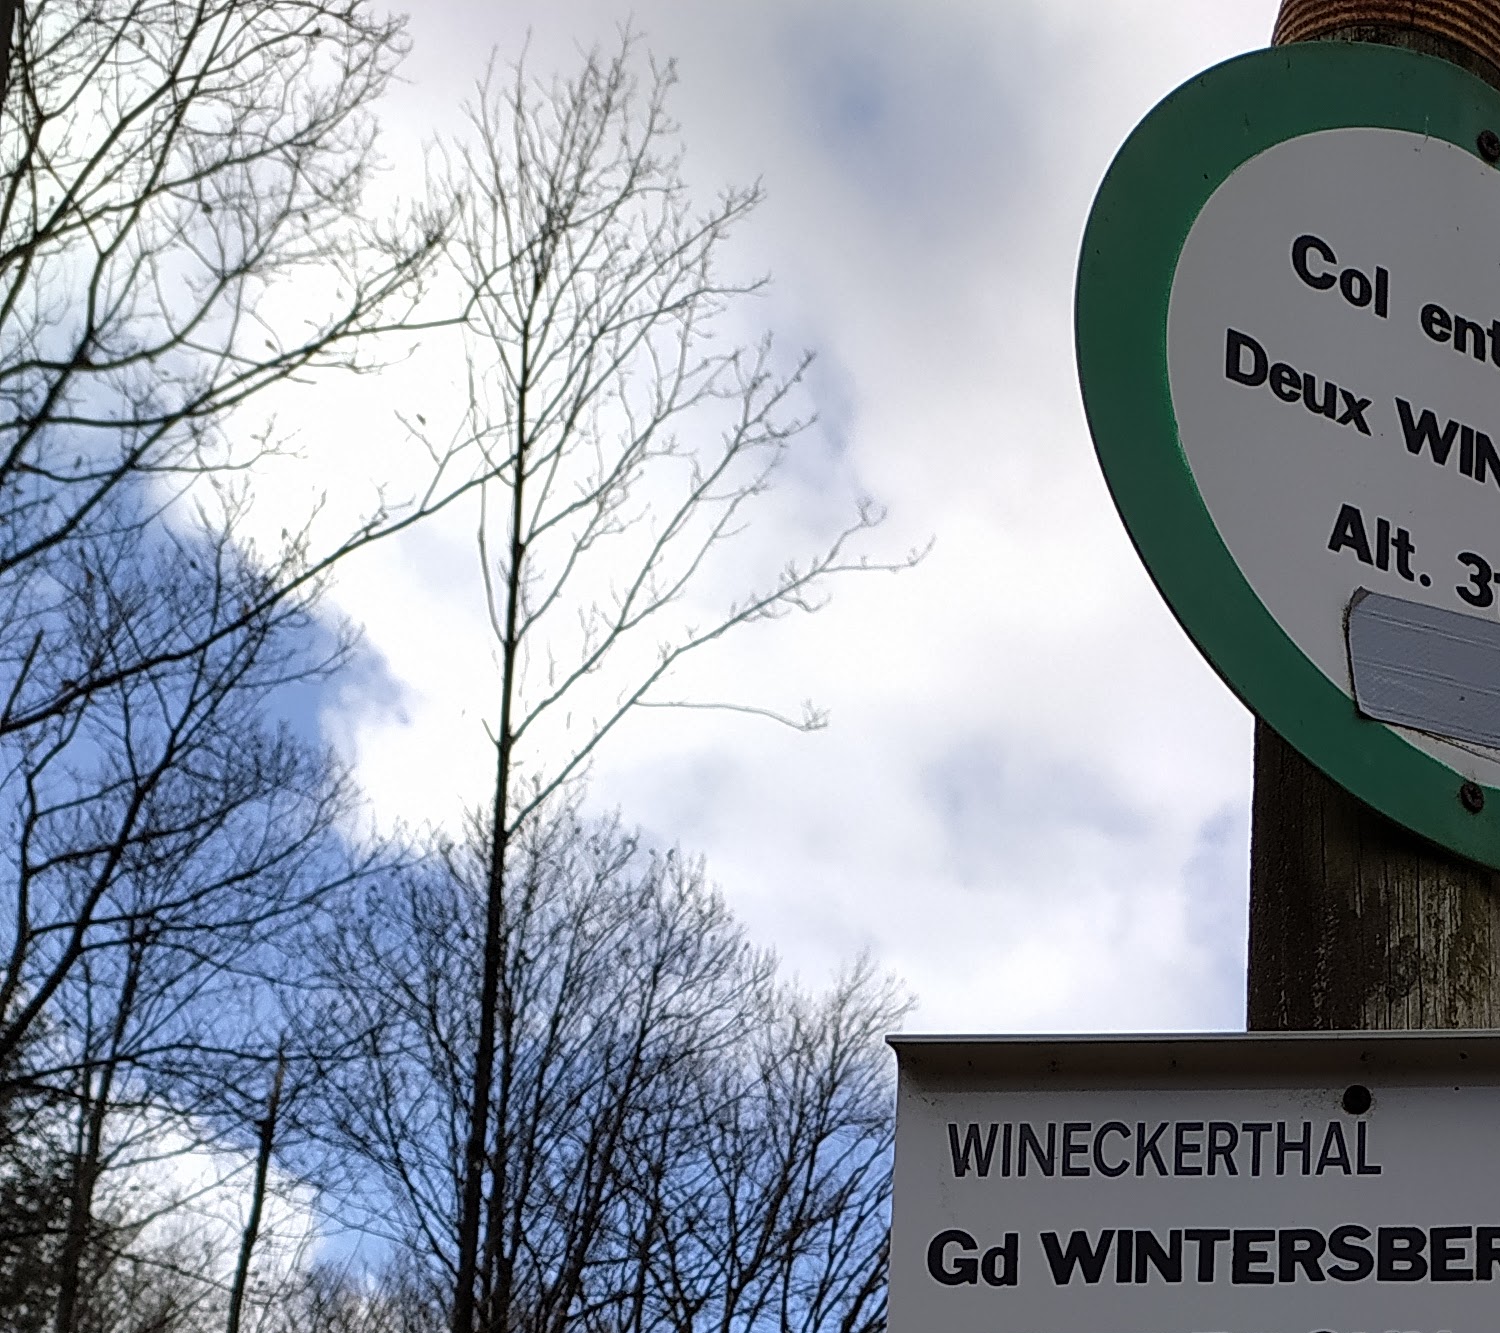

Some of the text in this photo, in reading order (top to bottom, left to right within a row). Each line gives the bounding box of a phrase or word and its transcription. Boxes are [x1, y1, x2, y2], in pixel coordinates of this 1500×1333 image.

[1291, 234, 1389, 319] Col
[1225, 328, 1372, 436] Deux
[1327, 503, 1432, 589] Alt.
[947, 1120, 1383, 1178] WINECKERTHAL
[926, 1230, 1020, 1288] Gd
